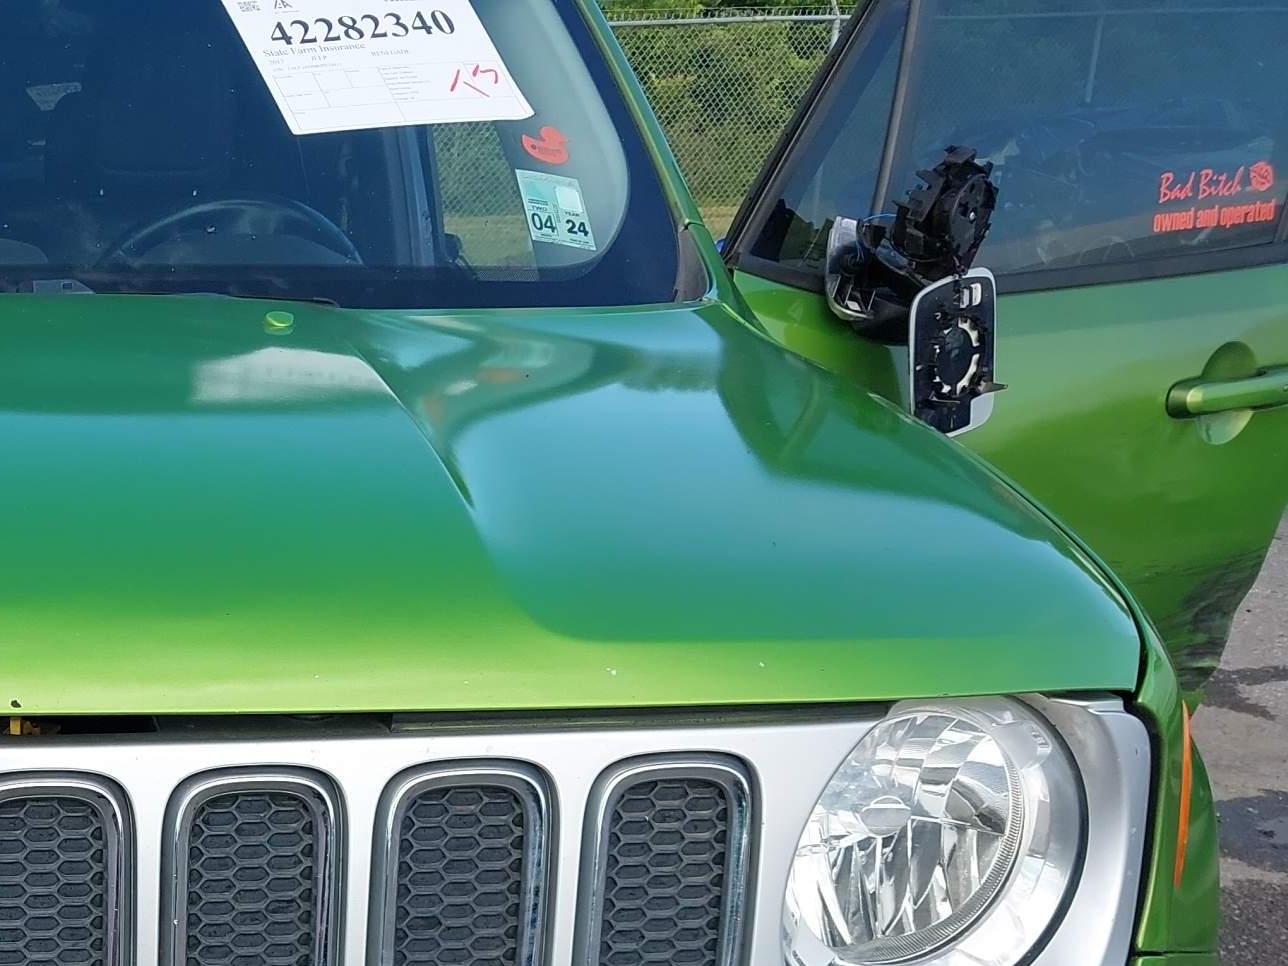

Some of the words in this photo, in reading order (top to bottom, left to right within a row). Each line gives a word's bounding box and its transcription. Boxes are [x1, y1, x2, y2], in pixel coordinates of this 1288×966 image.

[270, 9, 455, 46] 42282340
[263, 47, 289, 58] State
[291, 45, 317, 55] Farm
[318, 42, 366, 53] Insurance
[1159, 171, 1196, 204] Bad
[1198, 166, 1245, 200] Bitch
[531, 213, 556, 233] 04
[565, 219, 589, 237] 24
[1153, 207, 1195, 233] owned
[1196, 205, 1219, 229] and
[1220, 199, 1277, 229] operated
